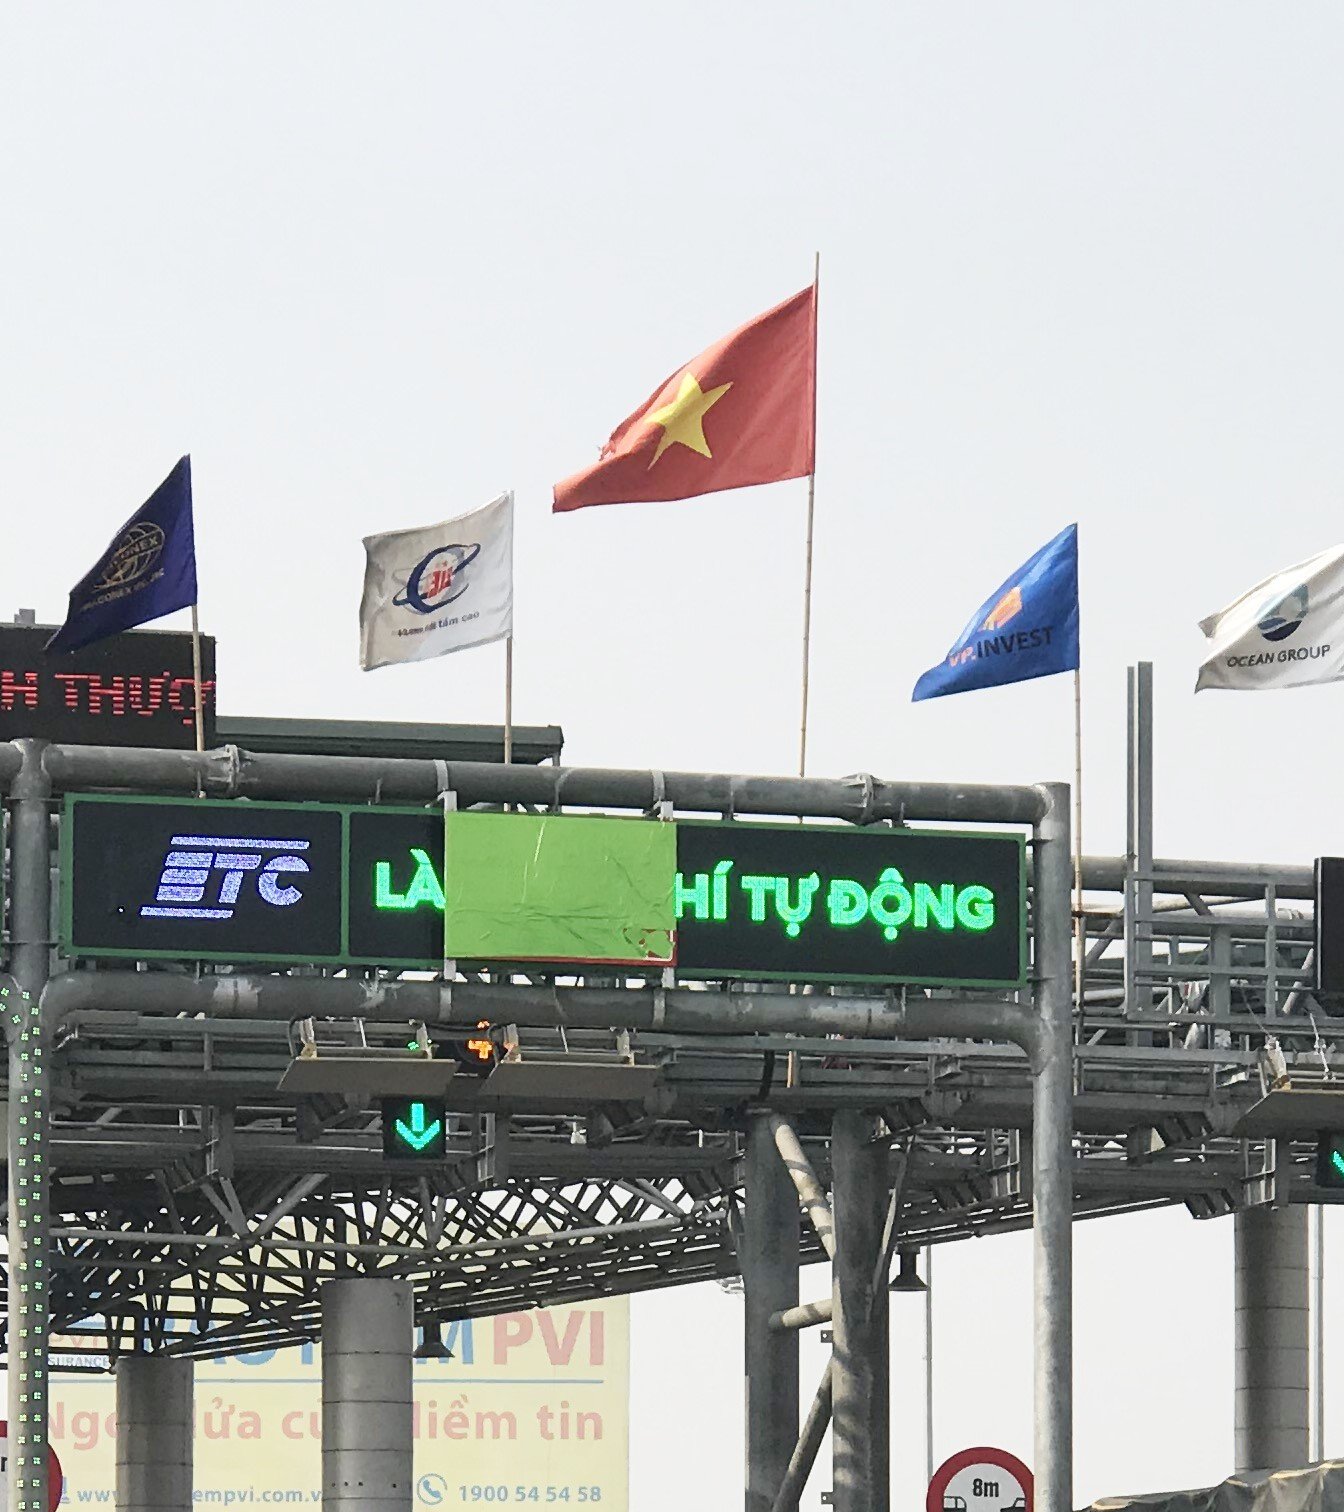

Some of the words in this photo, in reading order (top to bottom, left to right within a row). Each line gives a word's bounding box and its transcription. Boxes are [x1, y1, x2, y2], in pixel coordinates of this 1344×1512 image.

[1227, 653, 1275, 668] OCEAN
[1276, 644, 1331, 663] GROUP
[156, 851, 310, 906] ETC
[376, 849, 446, 909] LÀ
[674, 860, 733, 920] HÍ
[741, 872, 820, 938] TỰ
[827, 867, 995, 941] ĐỘNG
[493, 1310, 604, 1366] PVI
[194, 1397, 262, 1440] ửa
[536, 1400, 603, 1440] tin
[459, 1485, 508, 1502] 1900
[515, 1485, 541, 1502] 54
[546, 1485, 570, 1502] 54
[578, 1485, 602, 1502] 58
[973, 1477, 999, 1497] 8m
